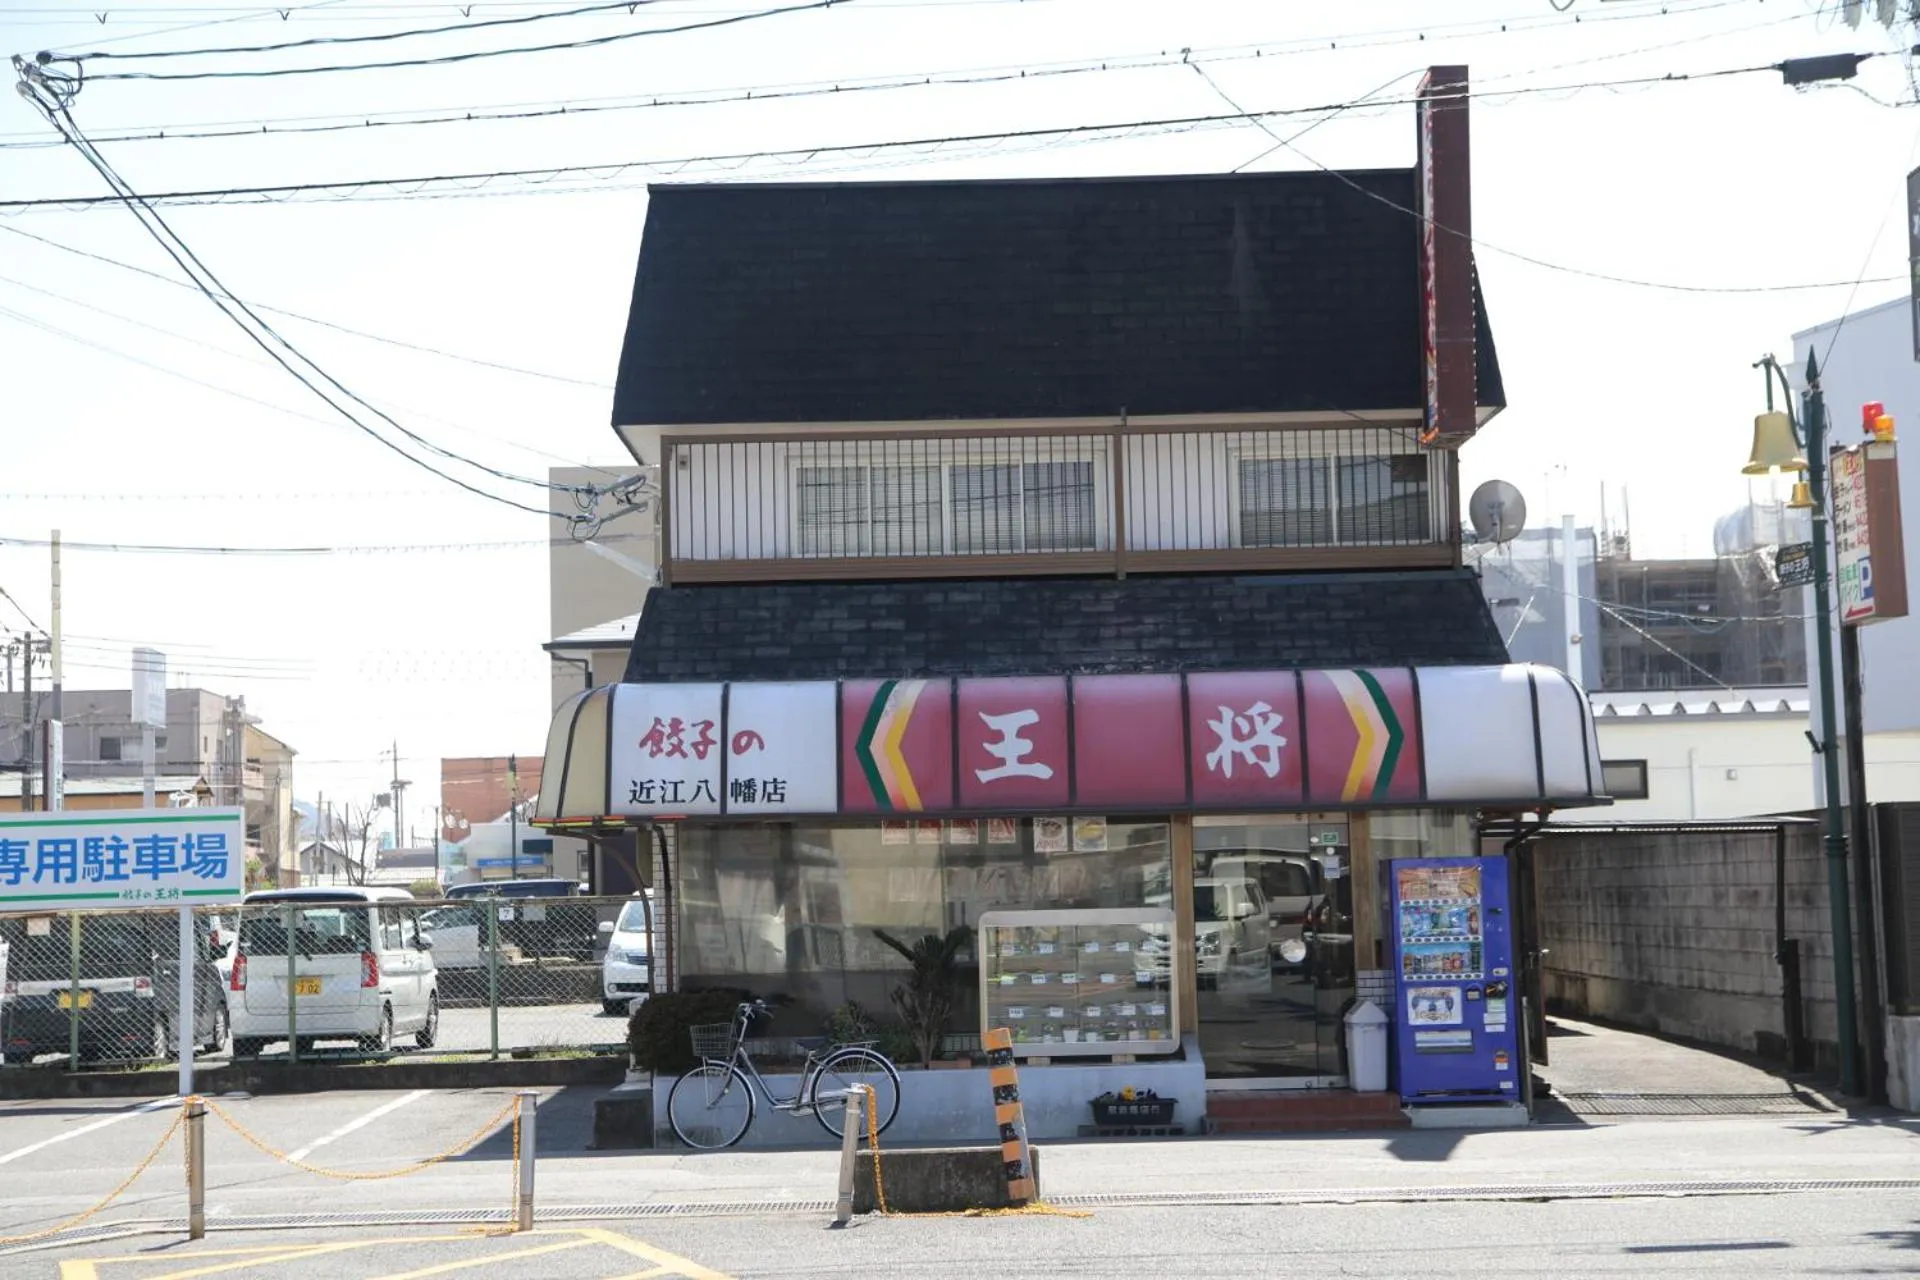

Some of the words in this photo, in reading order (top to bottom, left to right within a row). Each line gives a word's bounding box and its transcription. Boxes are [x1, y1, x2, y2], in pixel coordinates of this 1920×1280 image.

[1860, 559, 1872, 598] P
[638, 716, 765, 760] 餃子の
[974, 709, 1054, 784] 王
[1206, 700, 1287, 779] 将
[629, 778, 787, 804] 近江八幡店
[0, 833, 228, 885] 専用駐車場
